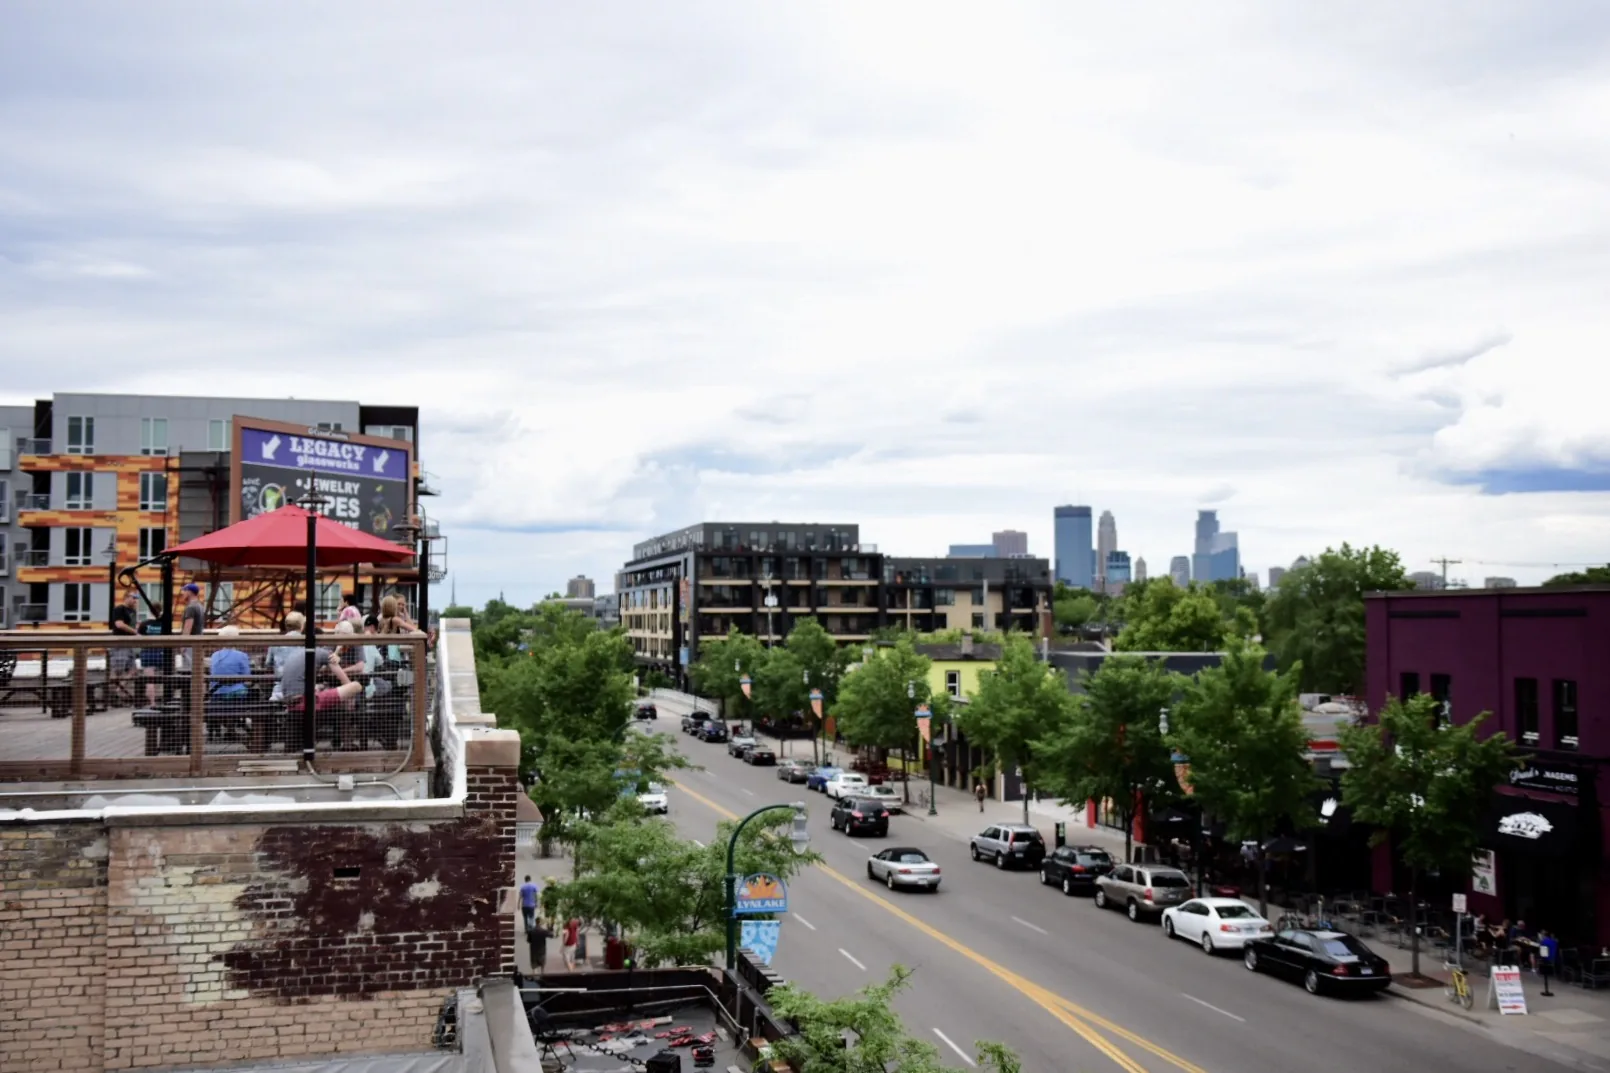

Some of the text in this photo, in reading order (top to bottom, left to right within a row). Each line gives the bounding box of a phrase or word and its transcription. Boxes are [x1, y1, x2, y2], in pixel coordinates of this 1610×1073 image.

[289, 436, 366, 461] LEGACY
[297, 454, 360, 470] glassworks
[303, 478, 361, 494] JEWELRY
[737, 899, 785, 909] LYNLAKE
